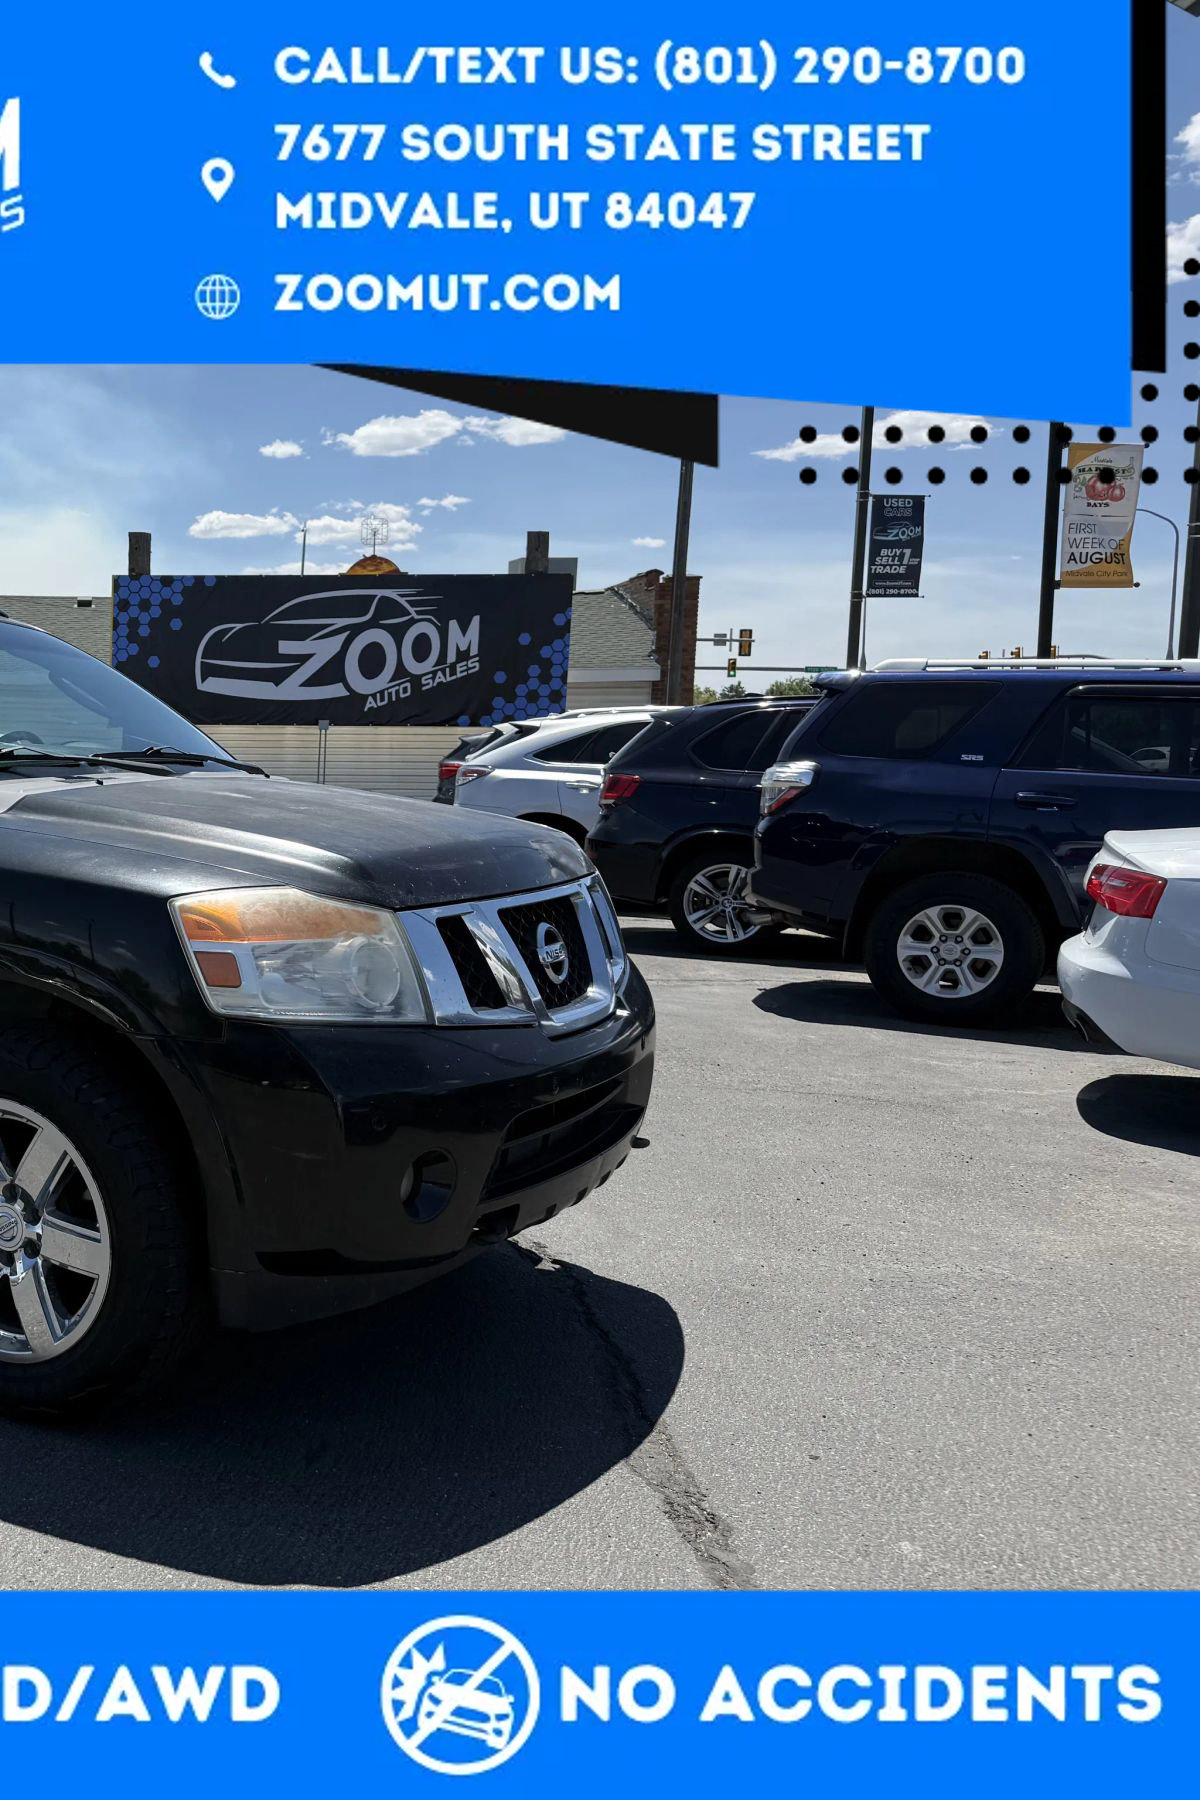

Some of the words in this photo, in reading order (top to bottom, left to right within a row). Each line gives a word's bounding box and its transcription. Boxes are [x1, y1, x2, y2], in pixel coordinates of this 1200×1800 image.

[883, 498, 913, 507] USED
[883, 507, 913, 517] CARS
[887, 525, 921, 540] ZOOM
[1068, 523, 1097, 534] FIRST
[1067, 536, 1106, 549] WEEK
[1107, 538, 1125, 551] OF
[880, 548, 903, 556] BUY
[874, 556, 901, 565] SELL
[1066, 551, 1126, 565] AUGUST
[870, 565, 907, 574] TRADE
[1096, 570, 1112, 578] City
[278, 614, 481, 700] ZOOM
[363, 681, 412, 712] AUTO
[420, 656, 480, 691] SALES
